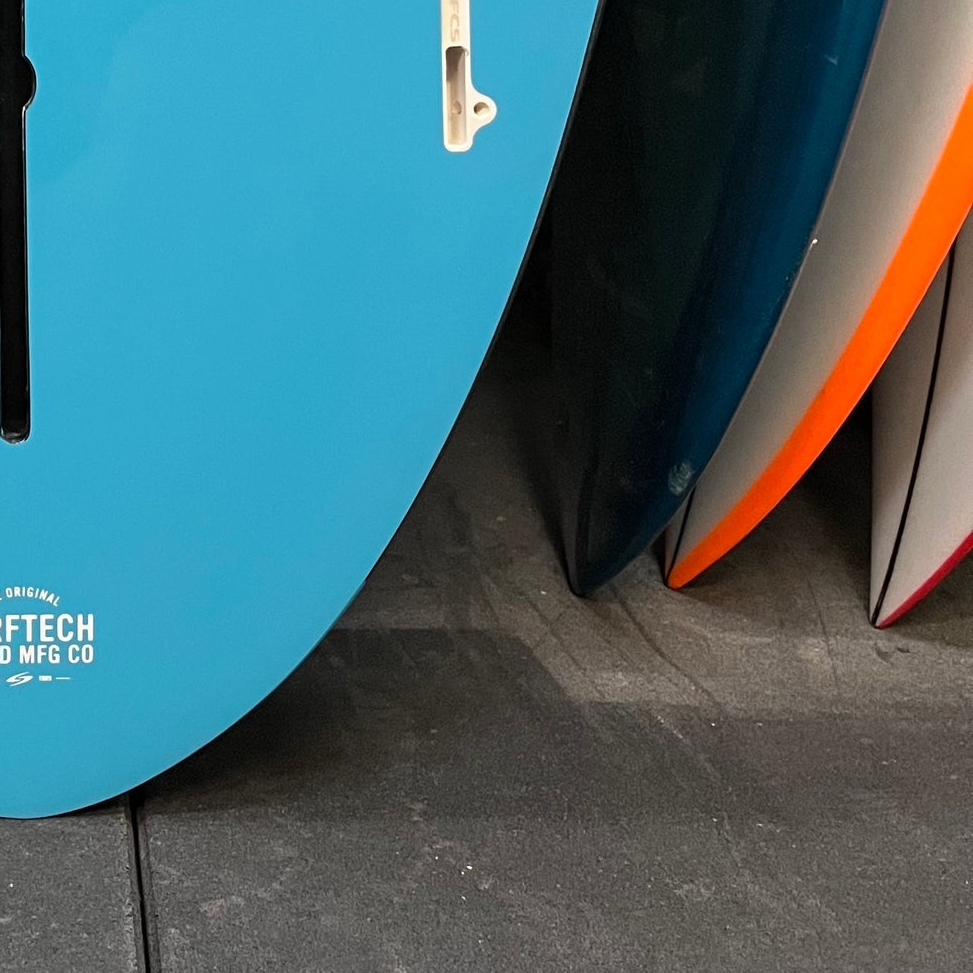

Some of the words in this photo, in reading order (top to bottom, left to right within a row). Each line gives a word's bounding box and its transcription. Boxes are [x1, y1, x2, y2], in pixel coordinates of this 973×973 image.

[5, 586, 62, 608] ORIGINAL
[19, 644, 61, 664] MFG
[68, 643, 95, 664] CO
